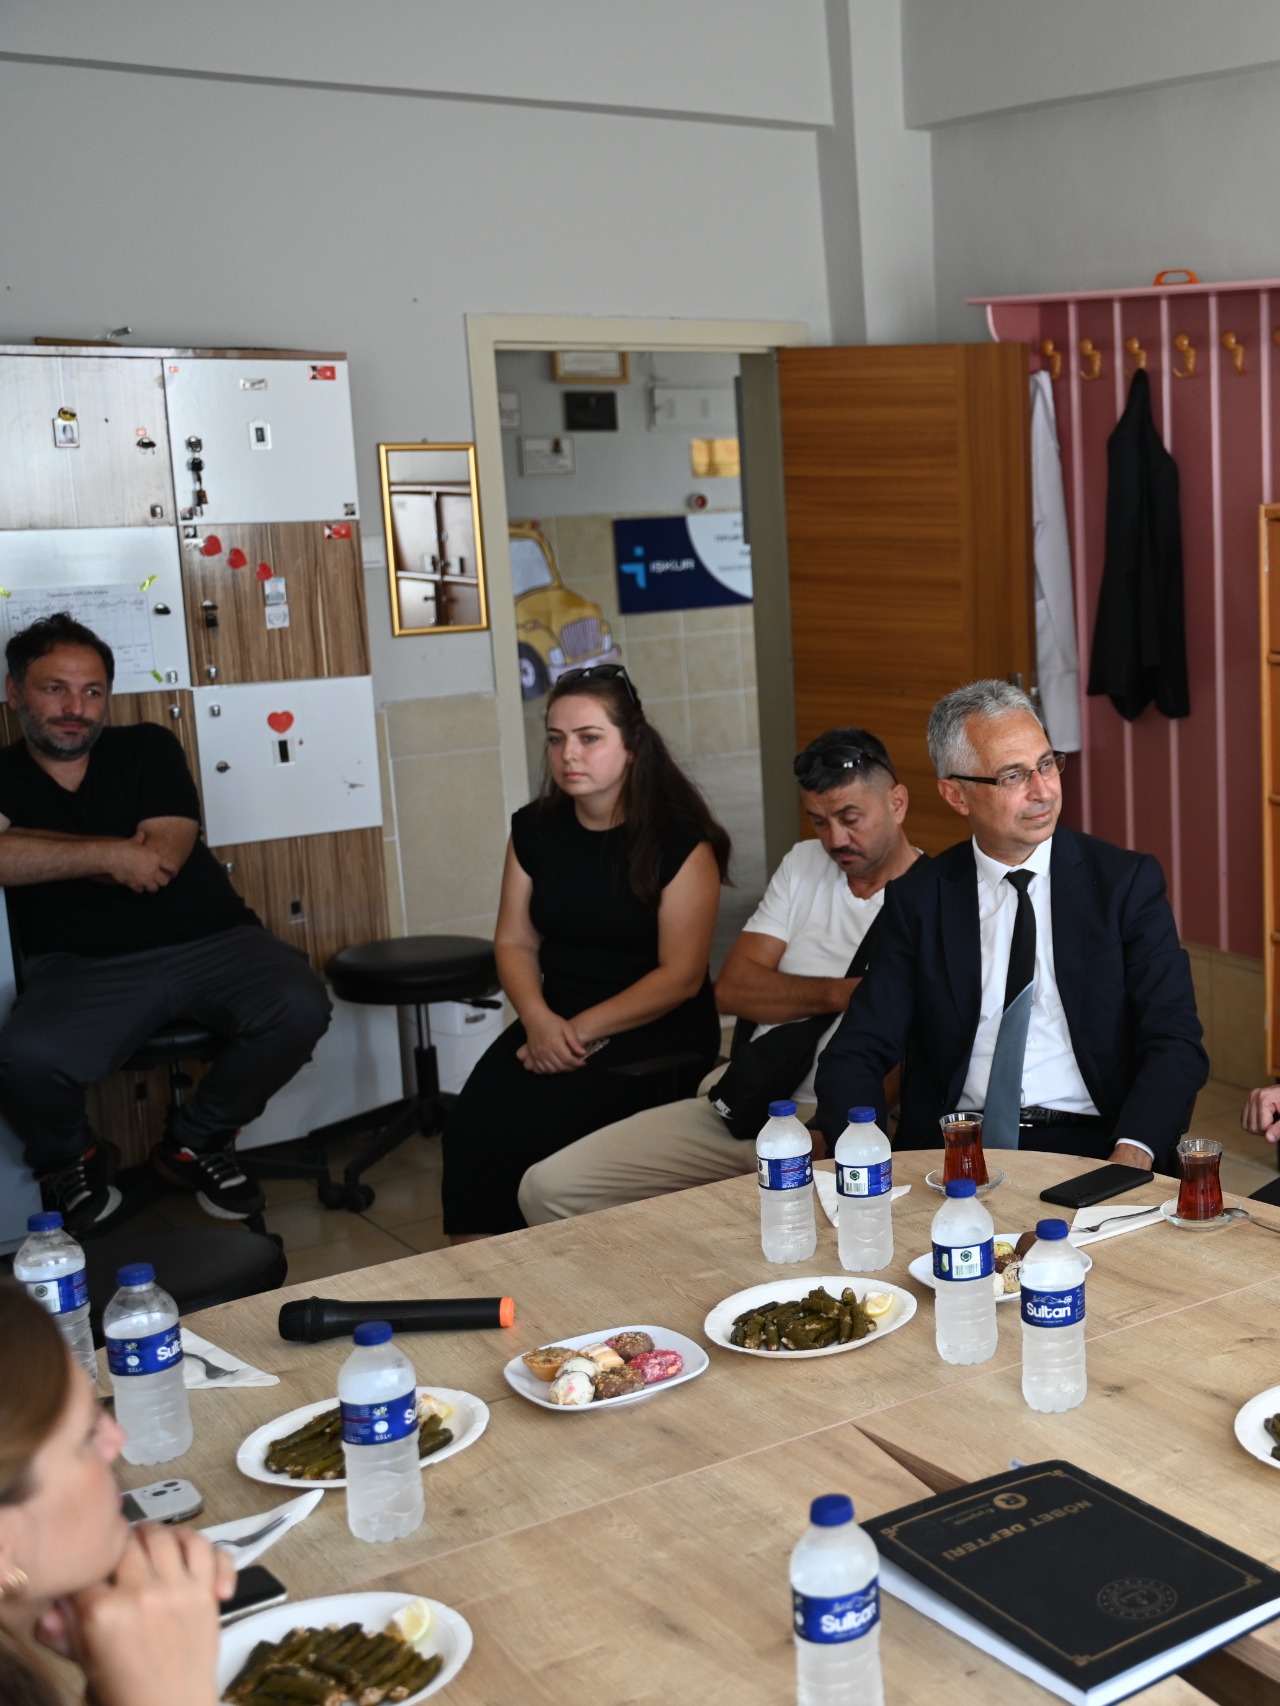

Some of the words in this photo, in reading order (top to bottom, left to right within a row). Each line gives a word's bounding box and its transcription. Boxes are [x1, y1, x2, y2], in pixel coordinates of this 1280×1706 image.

[1026, 1301, 1071, 1319] Sultan
[1029, 1499, 1093, 1527] NÖBET
[942, 1523, 1027, 1561] DEFTERİ
[820, 1601, 877, 1634] Sultan
